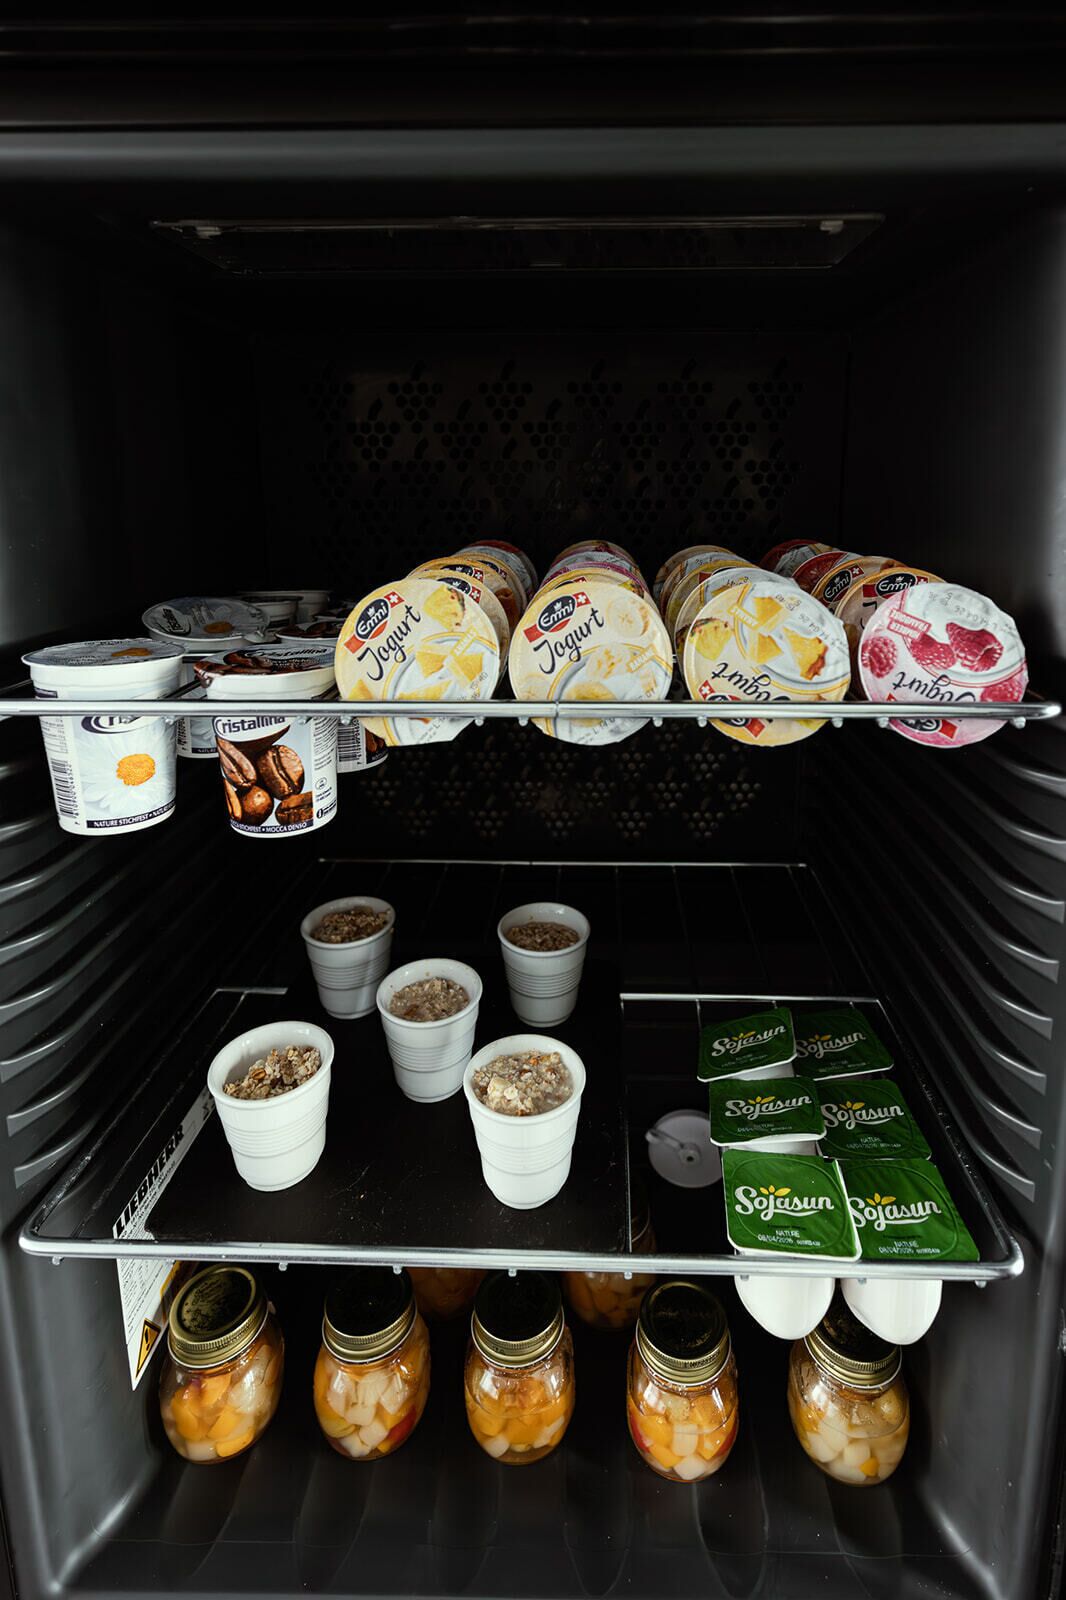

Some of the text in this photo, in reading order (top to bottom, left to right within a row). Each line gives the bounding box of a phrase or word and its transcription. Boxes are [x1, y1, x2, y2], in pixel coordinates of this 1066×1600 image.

[825, 575, 850, 597] Emmi
[878, 578, 915, 592] Emmi
[357, 602, 389, 635] Emmi
[540, 599, 574, 627] Emmi
[357, 604, 422, 681] Jogurt
[533, 607, 605, 675] Jogurt
[94, 820, 118, 828] NATURE
[118, 813, 149, 826] STICHFEST
[266, 825, 288, 833] MOCCA
[711, 1025, 786, 1057] Sojasun
[796, 1032, 867, 1059] Sojasun
[725, 1095, 812, 1120] Sojasun
[821, 1102, 904, 1130] Sojasun
[115, 1124, 184, 1236] LIEBHERR
[734, 1185, 834, 1221] Sojasun
[849, 1197, 942, 1232] Sojasun
[775, 1229, 801, 1239] NATURE
